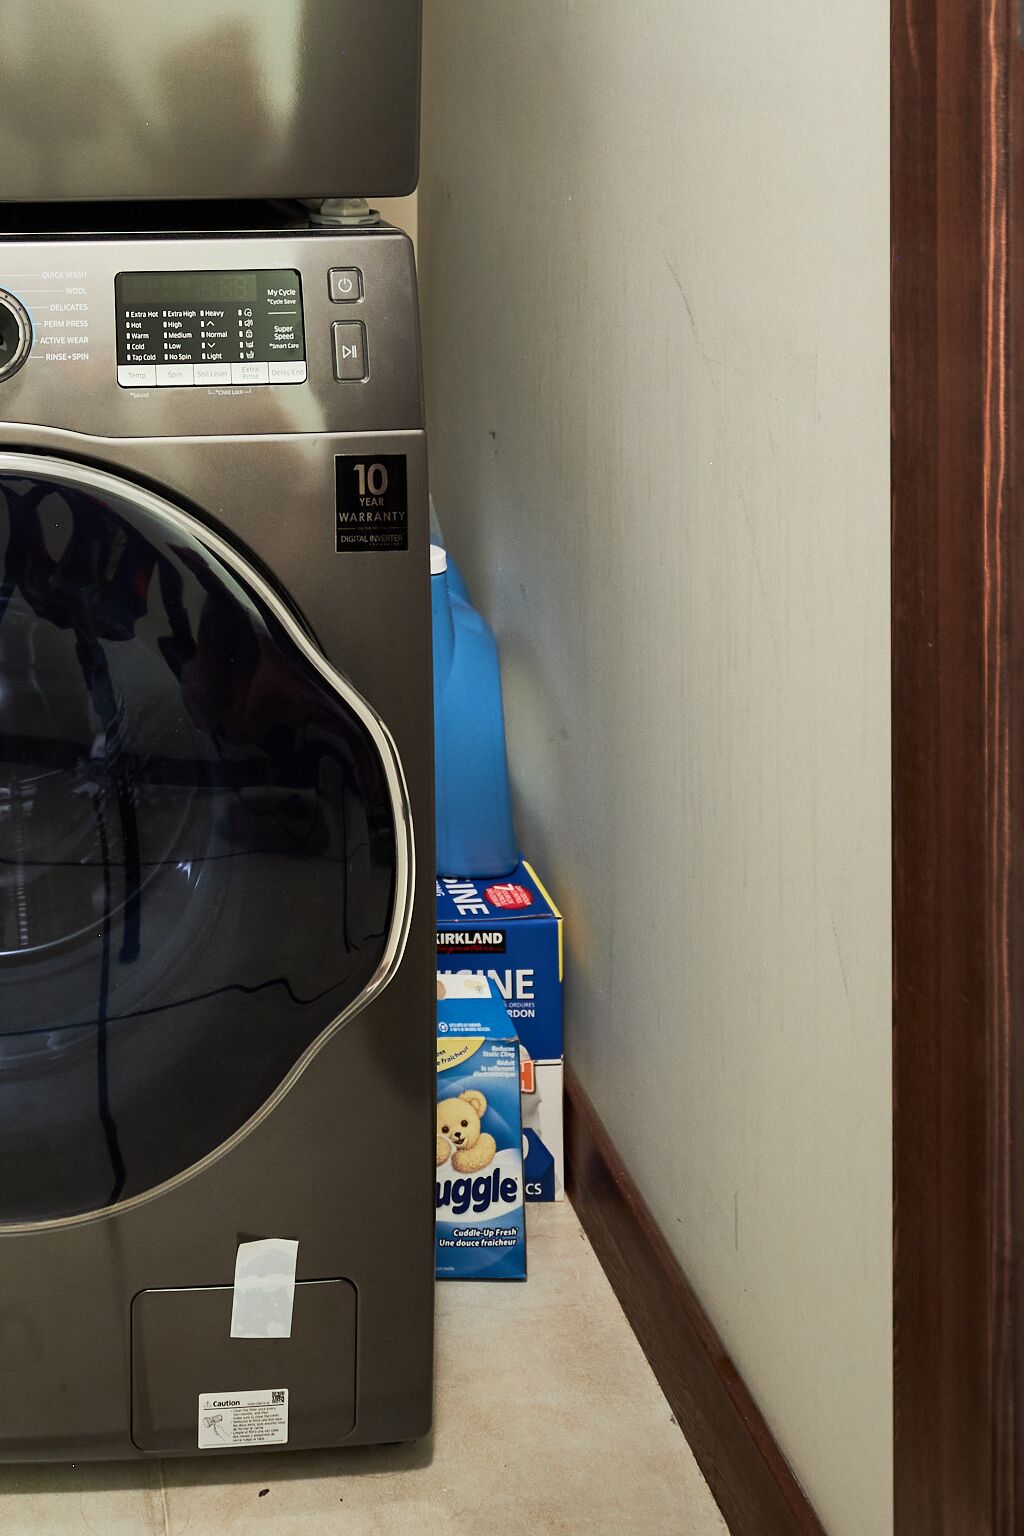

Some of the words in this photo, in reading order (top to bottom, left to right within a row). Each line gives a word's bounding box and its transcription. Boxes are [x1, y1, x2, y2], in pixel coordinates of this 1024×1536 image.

[267, 289, 278, 297] My
[278, 288, 296, 297] Cycle
[205, 310, 224, 318] Heavy
[43, 320, 64, 328] PERM
[168, 321, 182, 329] High
[274, 325, 293, 333] Super
[274, 333, 294, 341] Speed
[178, 353, 192, 361] Spin
[167, 371, 183, 379] Spin
[196, 370, 209, 378] Soil
[210, 370, 228, 378] Level
[271, 369, 290, 377] Delay
[291, 368, 304, 376] End
[353, 463, 388, 496] 10
[359, 497, 384, 507] YEAR
[338, 511, 405, 522] WARRANTY
[369, 534, 403, 543] INVERTER
[453, 1229, 495, 1238] Cuddle-Up
[495, 1228, 517, 1236] Fresh
[439, 1239, 455, 1247] Une
[456, 1239, 480, 1247] douce
